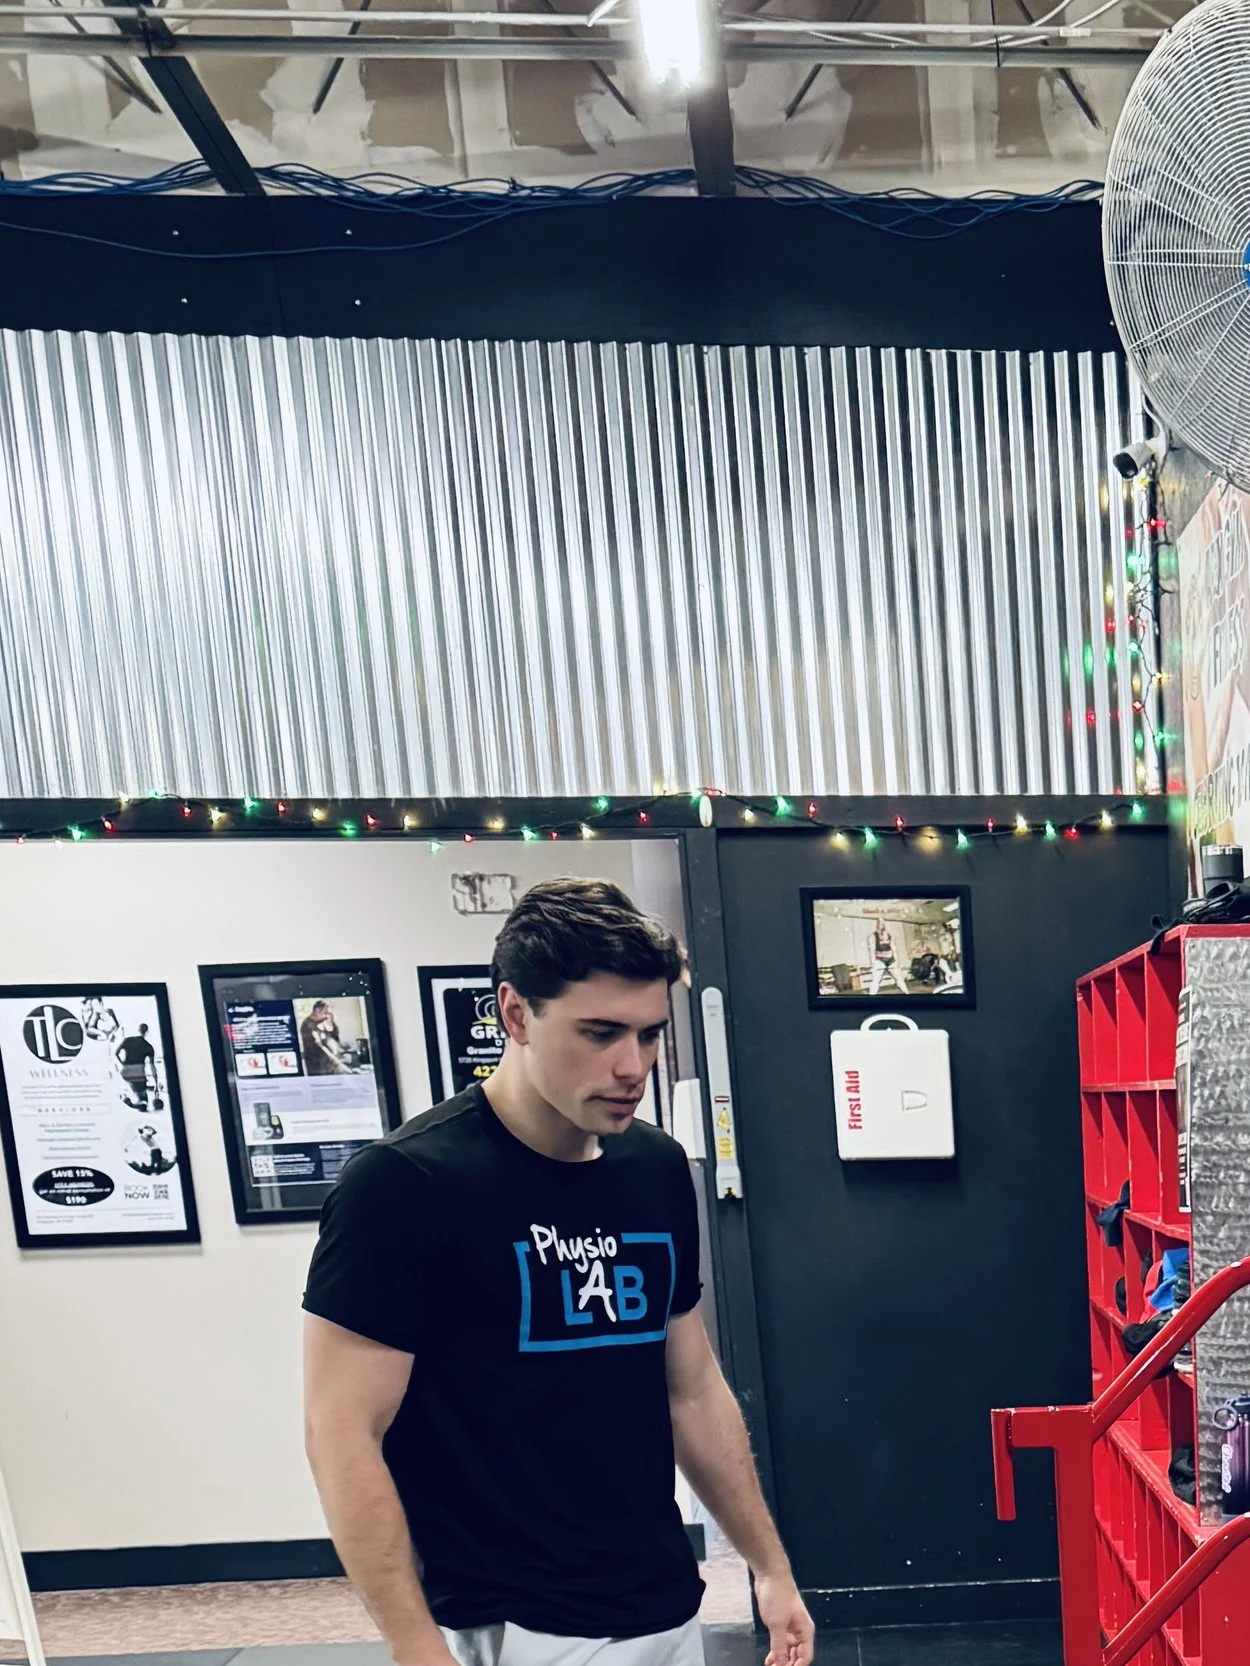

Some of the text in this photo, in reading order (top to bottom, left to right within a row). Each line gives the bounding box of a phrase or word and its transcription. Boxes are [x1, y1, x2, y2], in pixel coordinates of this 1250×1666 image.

[845, 1070, 863, 1130] First Aid
[529, 1223, 618, 1274] Physio
[560, 1259, 648, 1326] LAB
